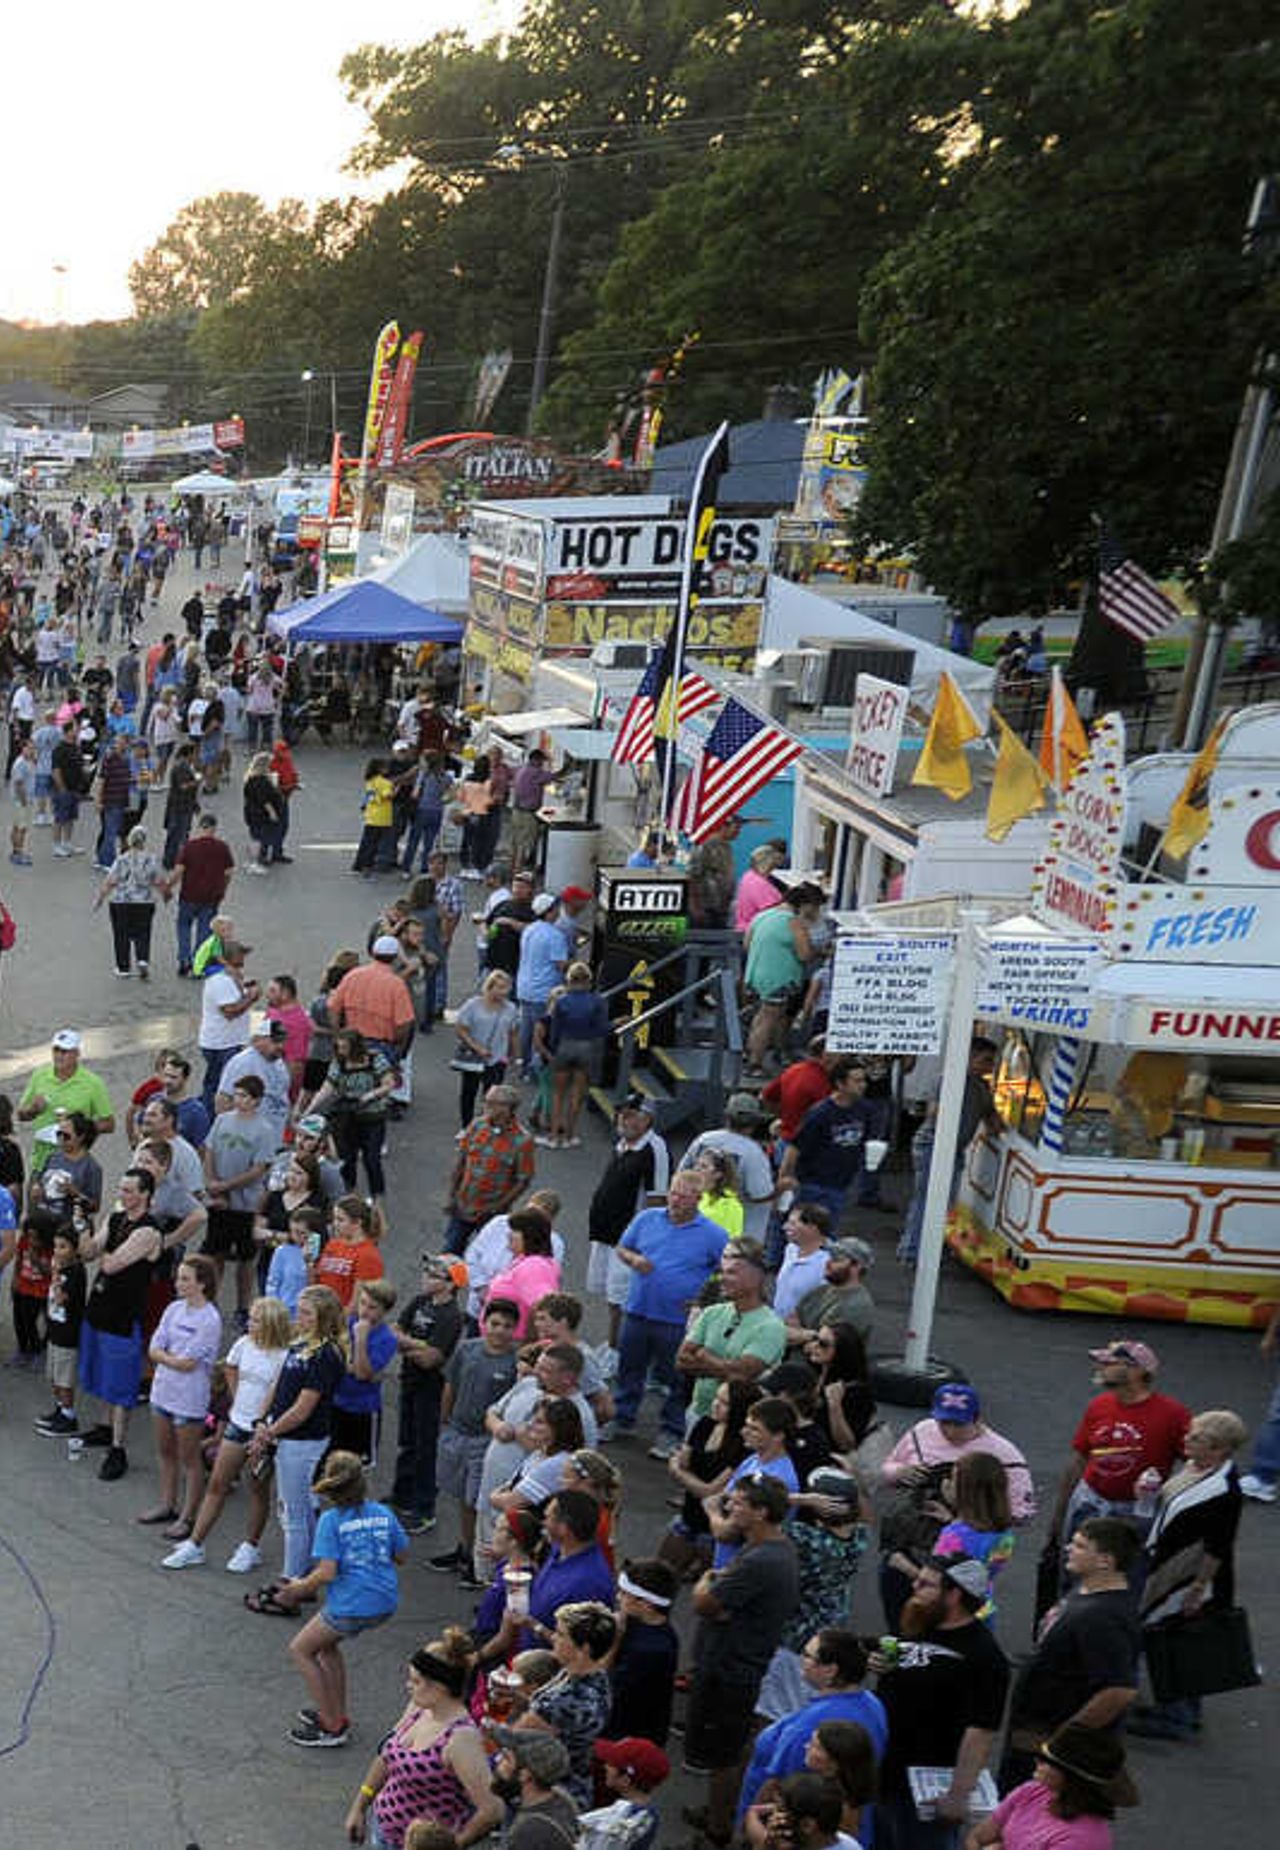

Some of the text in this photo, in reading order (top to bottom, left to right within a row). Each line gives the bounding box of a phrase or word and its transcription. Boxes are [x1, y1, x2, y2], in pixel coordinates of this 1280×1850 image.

[465, 458, 553, 481] ITALIAN
[560, 525, 640, 568] HOT
[653, 522, 761, 566] DGS
[1075, 790, 1112, 827] CORN
[619, 889, 679, 908] ATM
[1146, 905, 1256, 952] FRESH
[897, 940, 949, 949] SOUTH
[876, 952, 909, 962] EXIT
[1000, 957, 1040, 966] ARENA
[1034, 969, 1077, 980] OFFICE
[886, 978, 928, 988] BLDG
[1150, 1010, 1280, 1040] FUNNE
[883, 1042, 929, 1052] ARENA
